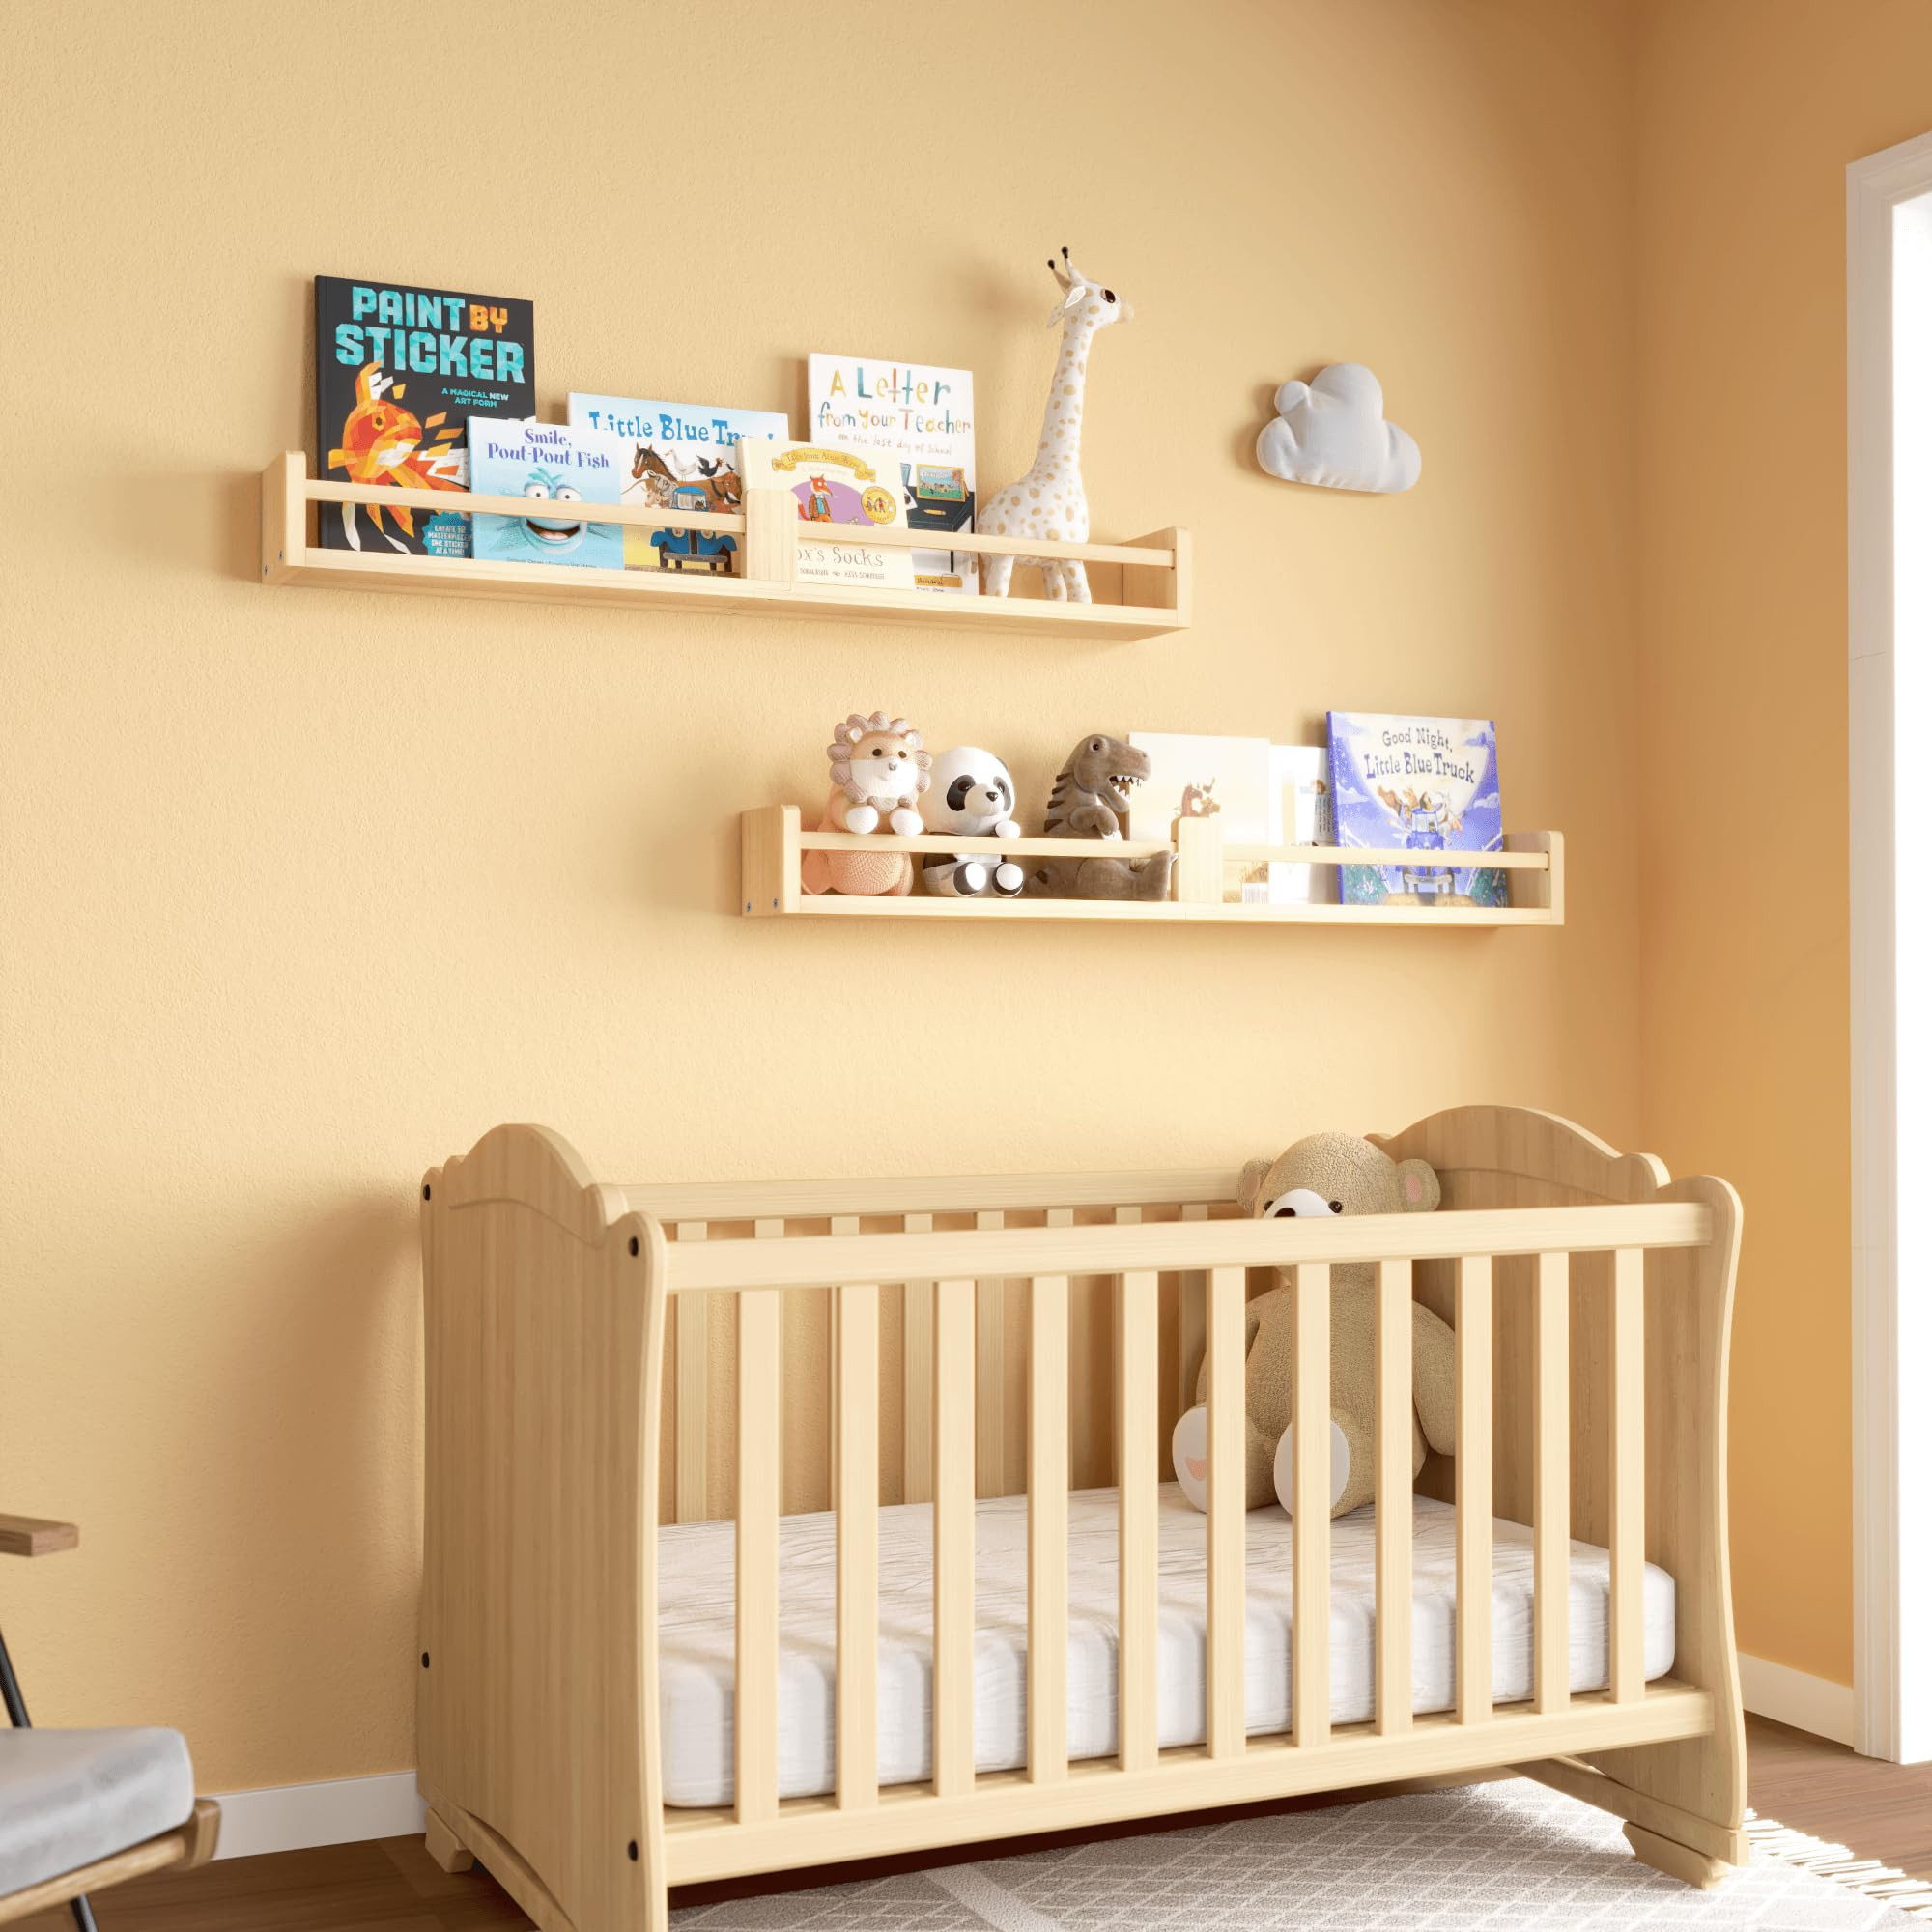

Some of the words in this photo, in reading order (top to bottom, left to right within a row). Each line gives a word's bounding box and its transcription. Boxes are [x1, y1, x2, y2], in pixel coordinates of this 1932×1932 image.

[353, 286, 465, 331] PAINT
[469, 304, 507, 333] BY
[335, 323, 525, 384] STICKER
[450, 388, 488, 399] MAGICAL
[489, 392, 509, 401] NEW
[830, 370, 846, 398] A
[857, 367, 951, 405] Letter
[473, 399, 497, 408] FORM
[818, 401, 856, 428] from
[858, 409, 896, 430] your
[898, 408, 971, 434] Teacher
[525, 428, 572, 448] Smile,
[588, 411, 653, 438] Little
[659, 413, 710, 442] Blue
[488, 442, 572, 465] Pout-Pout
[578, 451, 610, 469] Fish
[797, 546, 825, 562] ox's
[833, 546, 884, 567] Socks
[1382, 726, 1411, 747] Good
[1416, 728, 1453, 753] Night,
[1364, 752, 1401, 779] Little
[1403, 752, 1432, 774] Blue
[1433, 752, 1474, 784] Truck
